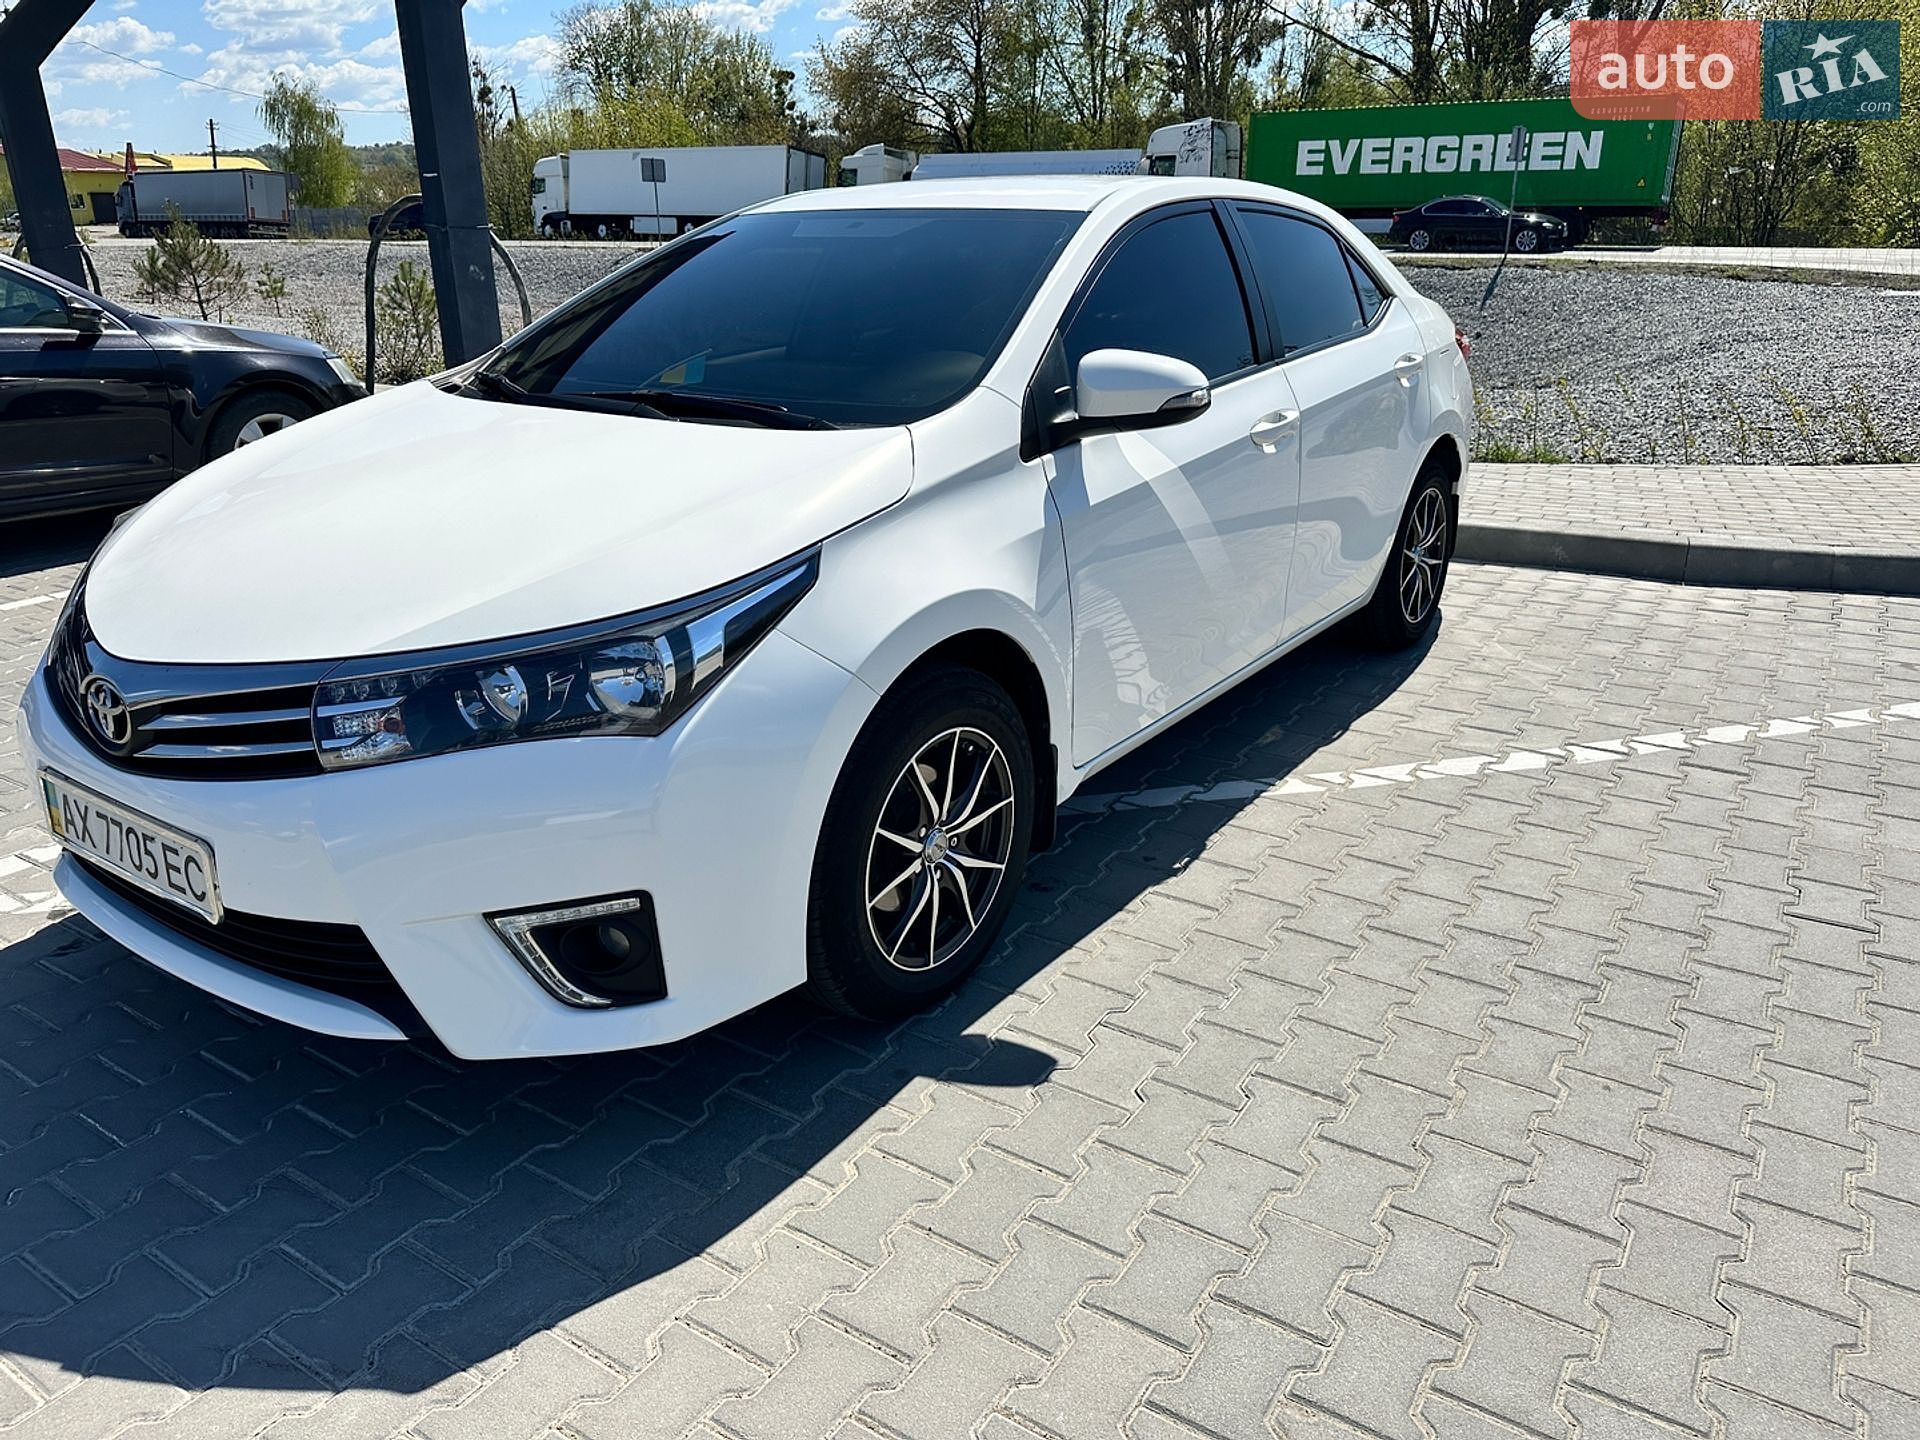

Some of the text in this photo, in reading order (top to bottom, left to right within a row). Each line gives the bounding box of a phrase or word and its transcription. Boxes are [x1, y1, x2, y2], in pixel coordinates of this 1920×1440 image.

[1296, 130, 1604, 175] EVERGREEN
[62, 794, 207, 902] AX 7705 EC
